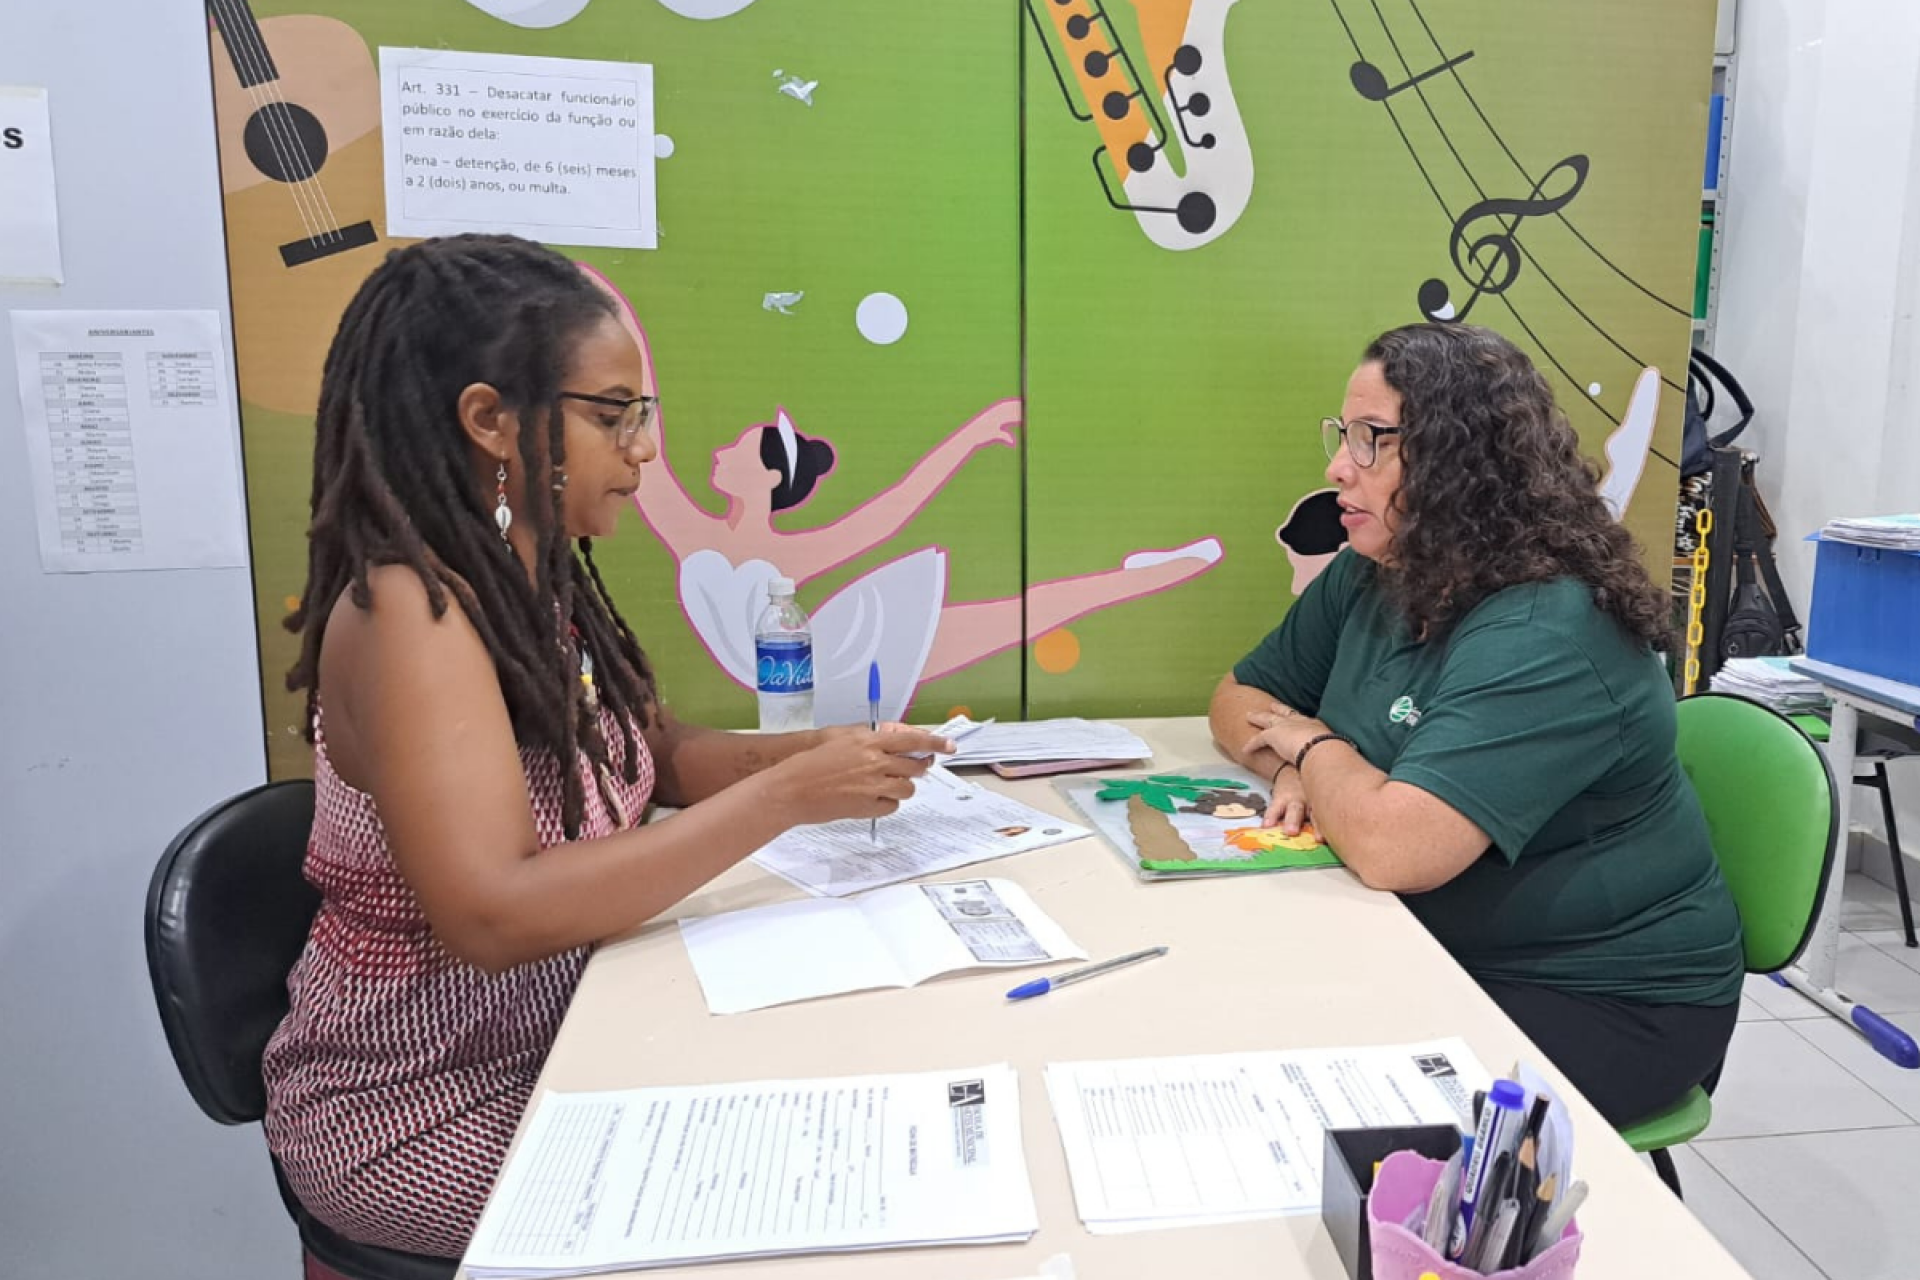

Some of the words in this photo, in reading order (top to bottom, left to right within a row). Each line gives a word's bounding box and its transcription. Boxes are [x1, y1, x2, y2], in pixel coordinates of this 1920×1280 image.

[402, 80, 426, 94] Art.
[437, 83, 460, 96] 331
[488, 86, 552, 101] Desacatar
[561, 91, 635, 107] funcionário
[403, 102, 451, 116] público
[458, 108, 475, 117] no
[481, 109, 539, 122] exercício
[546, 111, 561, 123] da
[568, 112, 613, 128] função
[619, 116, 636, 128] ou
[403, 126, 424, 135] em
[429, 126, 464, 138] razão
[468, 128, 499, 139] dela:
[405, 153, 437, 167] Pena
[456, 157, 519, 173] detenção,
[524, 160, 541, 172] de
[545, 161, 554, 173] 6
[558, 162, 591, 176] (seis)
[596, 167, 636, 178] meses
[406, 177, 413, 186] a
[417, 175, 424, 187] 2
[429, 176, 466, 191] (dois)
[470, 181, 504, 192] anos,
[509, 183, 525, 192] ou
[529, 182, 570, 194] multa.
